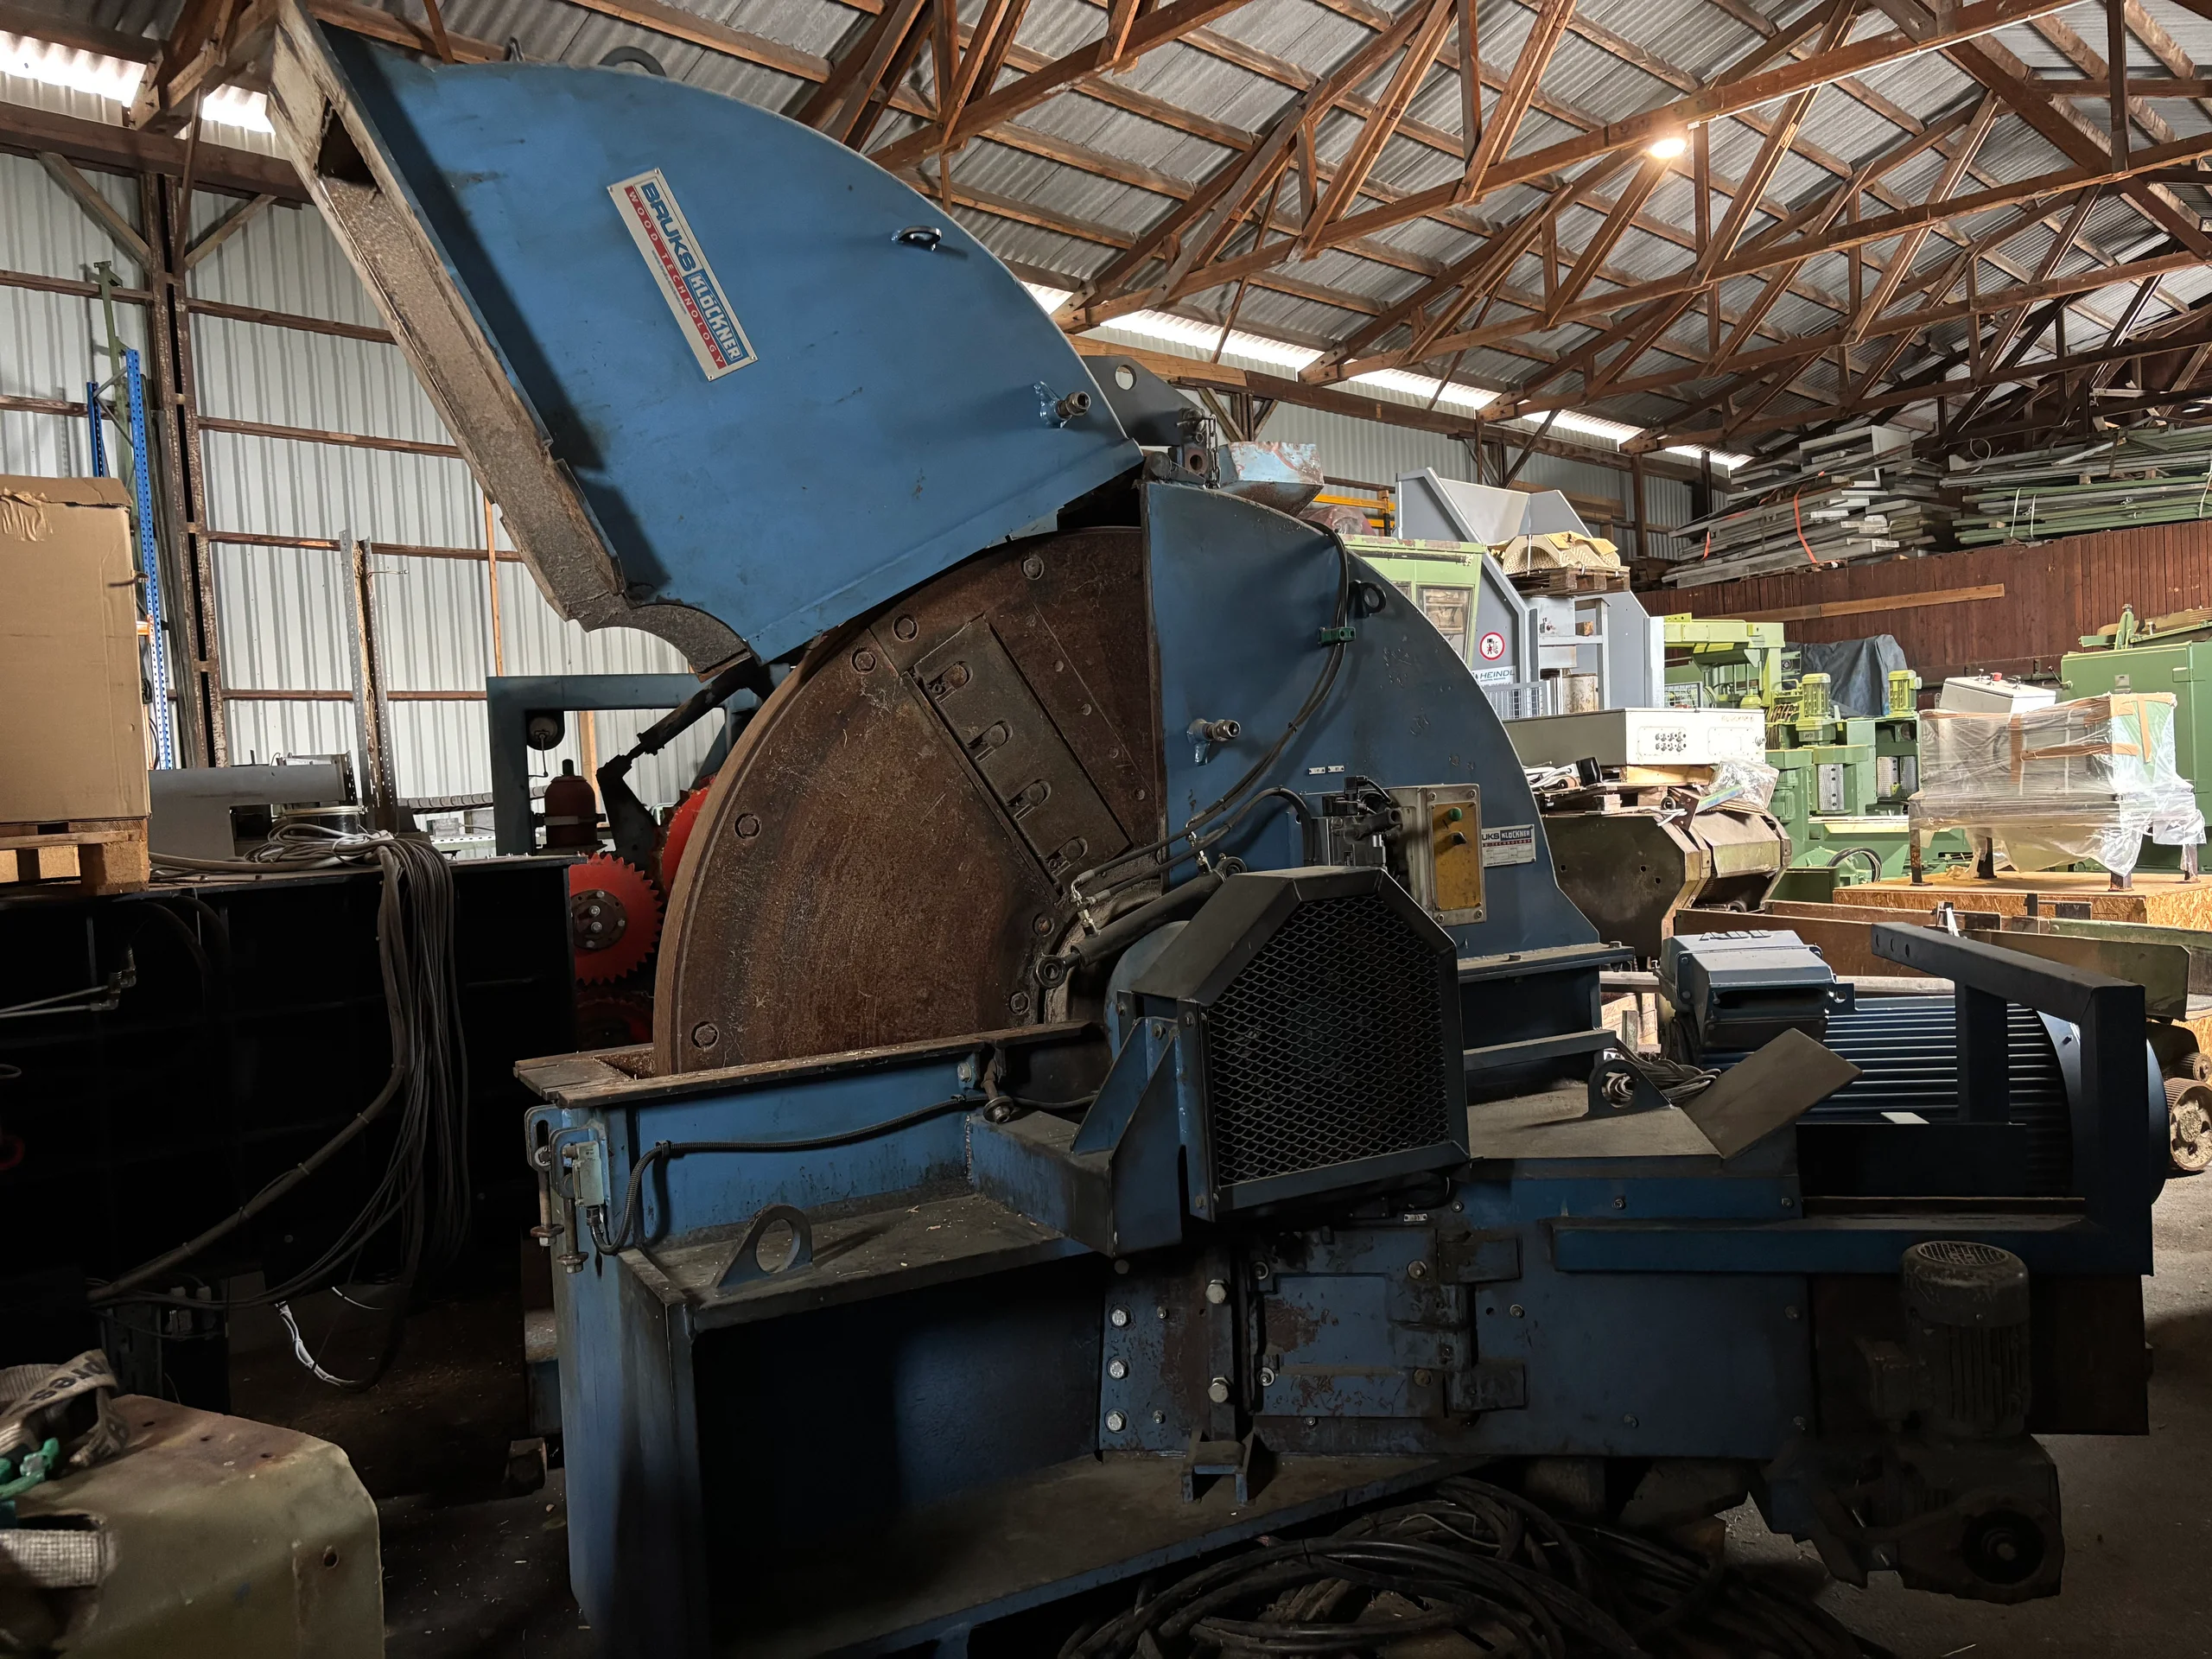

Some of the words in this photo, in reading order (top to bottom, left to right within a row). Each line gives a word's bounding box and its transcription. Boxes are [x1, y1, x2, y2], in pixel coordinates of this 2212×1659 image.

[628, 191, 658, 242] WOOD
[662, 253, 724, 369] TECHNOLOGY
[640, 181, 696, 272] BRUKS
[690, 275, 741, 360] KLÖCKNER
[1480, 670, 1516, 679] HEINDL
[1481, 832, 1500, 841] UKS
